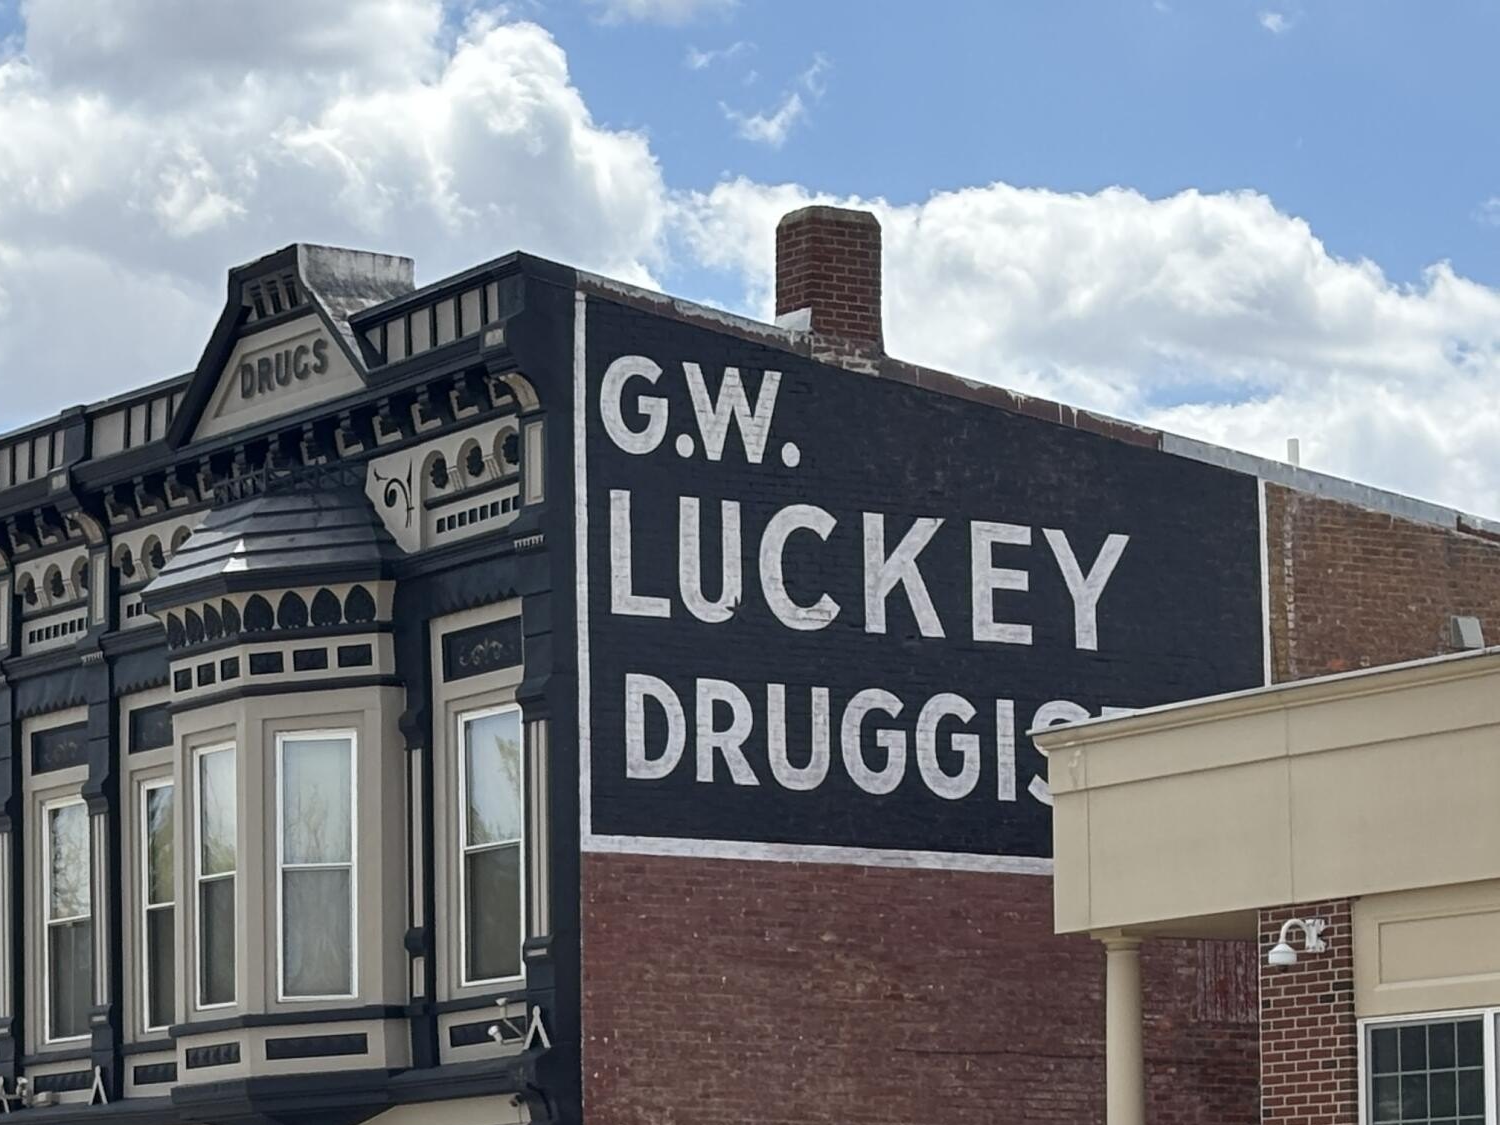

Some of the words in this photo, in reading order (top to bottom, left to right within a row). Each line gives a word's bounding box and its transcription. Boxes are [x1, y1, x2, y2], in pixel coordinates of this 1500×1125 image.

[241, 338, 328, 399] DRUGS
[599, 354, 802, 468] G.W.
[609, 488, 1131, 652] LUCKEY
[624, 673, 1141, 808] DRUGGIS
